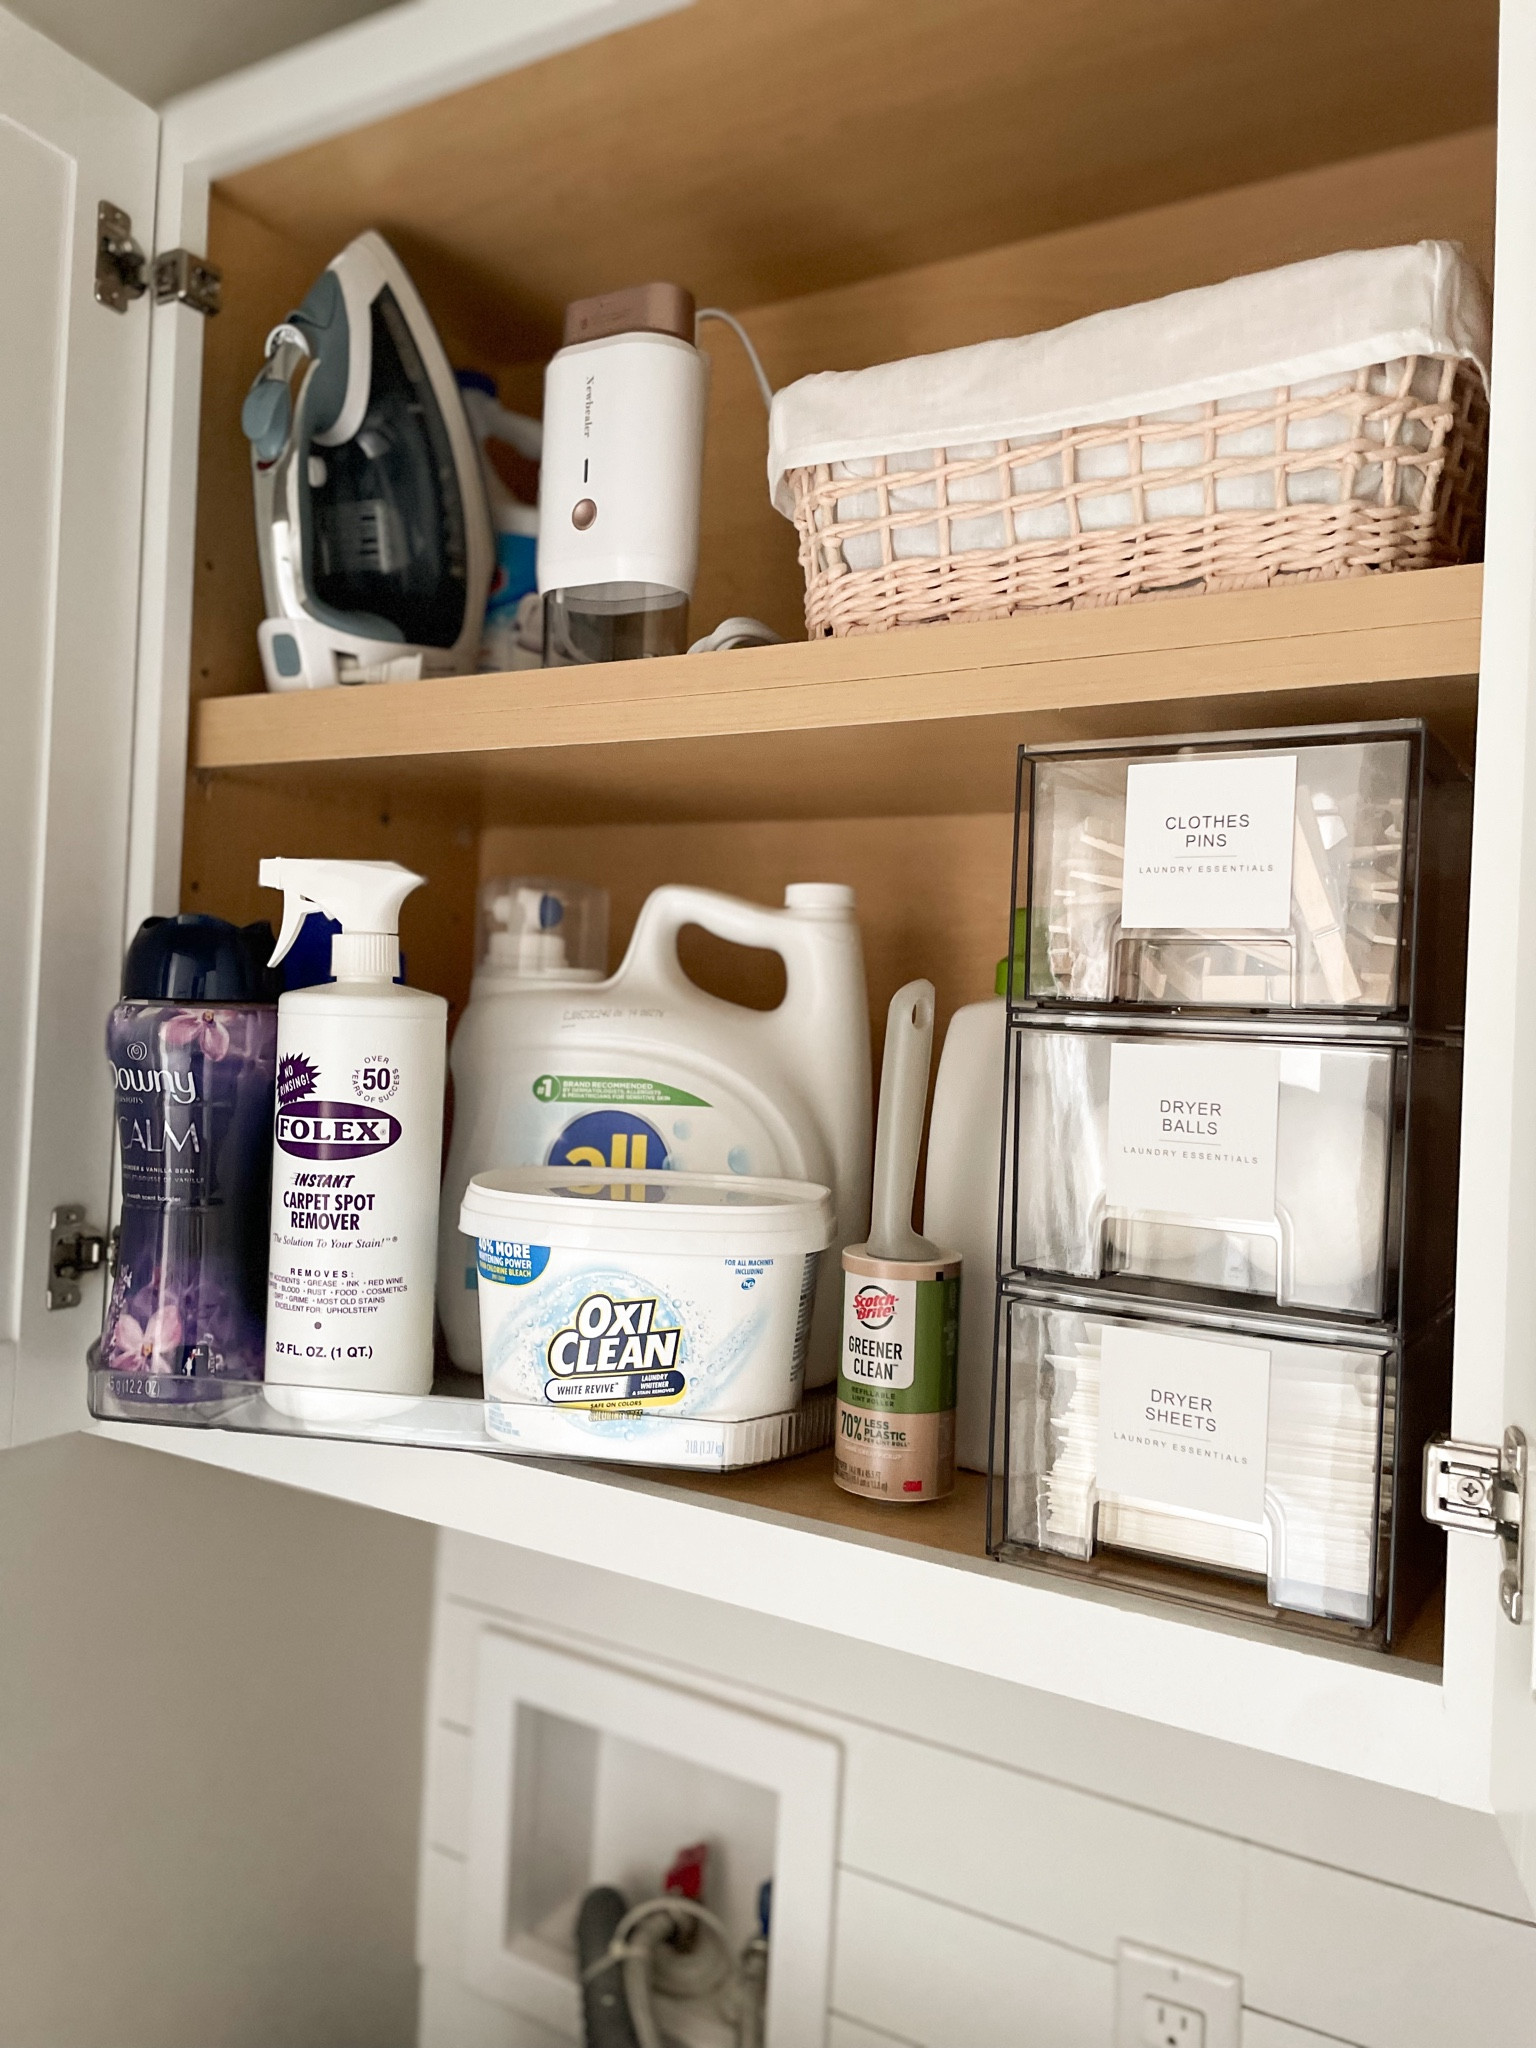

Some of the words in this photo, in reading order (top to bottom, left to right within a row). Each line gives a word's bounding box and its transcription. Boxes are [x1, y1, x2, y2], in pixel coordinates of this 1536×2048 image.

[1165, 814, 1250, 830] CLOTHES
[1185, 834, 1227, 848] PINS
[1139, 866, 1193, 874] LAUNDRY
[1198, 864, 1274, 873] ESSENTIALS
[364, 1055, 389, 1064] OVER
[284, 1065, 293, 1078] NO
[363, 1068, 390, 1090] 50
[280, 1072, 310, 1097] RINSING!
[352, 1069, 363, 1096] YEARS
[363, 1095, 376, 1103] OF
[378, 1068, 400, 1103] SUCCESS
[537, 1079, 553, 1098] #1
[592, 1081, 653, 1090] RECOMMENDED
[1160, 1099, 1222, 1117] DRYER
[280, 1117, 380, 1141] FOLEX
[1162, 1118, 1218, 1135] BALLS
[118, 1116, 200, 1153] CALM
[1123, 1146, 1177, 1157] LAUNDRY
[1182, 1151, 1259, 1165] ESSENTIALS
[146, 1166, 172, 1174] VANILLA
[294, 1173, 355, 1188] INSTANT
[283, 1191, 330, 1210] CARPET
[334, 1194, 375, 1211] SPOT
[291, 1211, 360, 1230] REMOVER
[283, 1235, 313, 1247] Solution
[316, 1239, 327, 1248] To
[331, 1239, 352, 1248] Your
[496, 1241, 531, 1258] MORE
[505, 1258, 532, 1269] POWER
[290, 1267, 354, 1278] REMOVES:
[509, 1268, 532, 1278] BLEACH
[307, 1279, 337, 1287] GREASE
[385, 1277, 404, 1285] WINE
[281, 1285, 300, 1294] BLOOD
[366, 1285, 408, 1296] COSMETICS
[275, 1300, 304, 1313] EXCELLENT
[326, 1306, 378, 1314] UPHOLSTERY
[288, 1295, 309, 1304] GRIME
[358, 1297, 385, 1305] STAINS
[579, 1296, 653, 1339] OXI
[856, 1306, 892, 1320] Brite
[275, 1341, 285, 1353] 32
[287, 1343, 302, 1356] FL.
[306, 1346, 326, 1358] OZ.
[331, 1347, 342, 1360] (1
[347, 1346, 373, 1359] QT.)
[550, 1331, 677, 1375] CLEAN
[848, 1335, 902, 1361] GREENER
[853, 1358, 893, 1380] CLEAN
[641, 1373, 668, 1382] LAUNDRY
[557, 1385, 582, 1396] WHITE
[585, 1383, 615, 1395] REVIVE
[851, 1386, 895, 1399] REFILLABLE
[866, 1397, 894, 1407] ROLLER
[1151, 1389, 1212, 1412] DRYER
[841, 1410, 862, 1441] 70%
[864, 1418, 889, 1430] LESS
[1145, 1407, 1217, 1432] SHEETS
[864, 1428, 906, 1441] PLASTIC
[1113, 1432, 1167, 1448] LAUNDRY
[1172, 1443, 1248, 1465] ESSENTIALS
